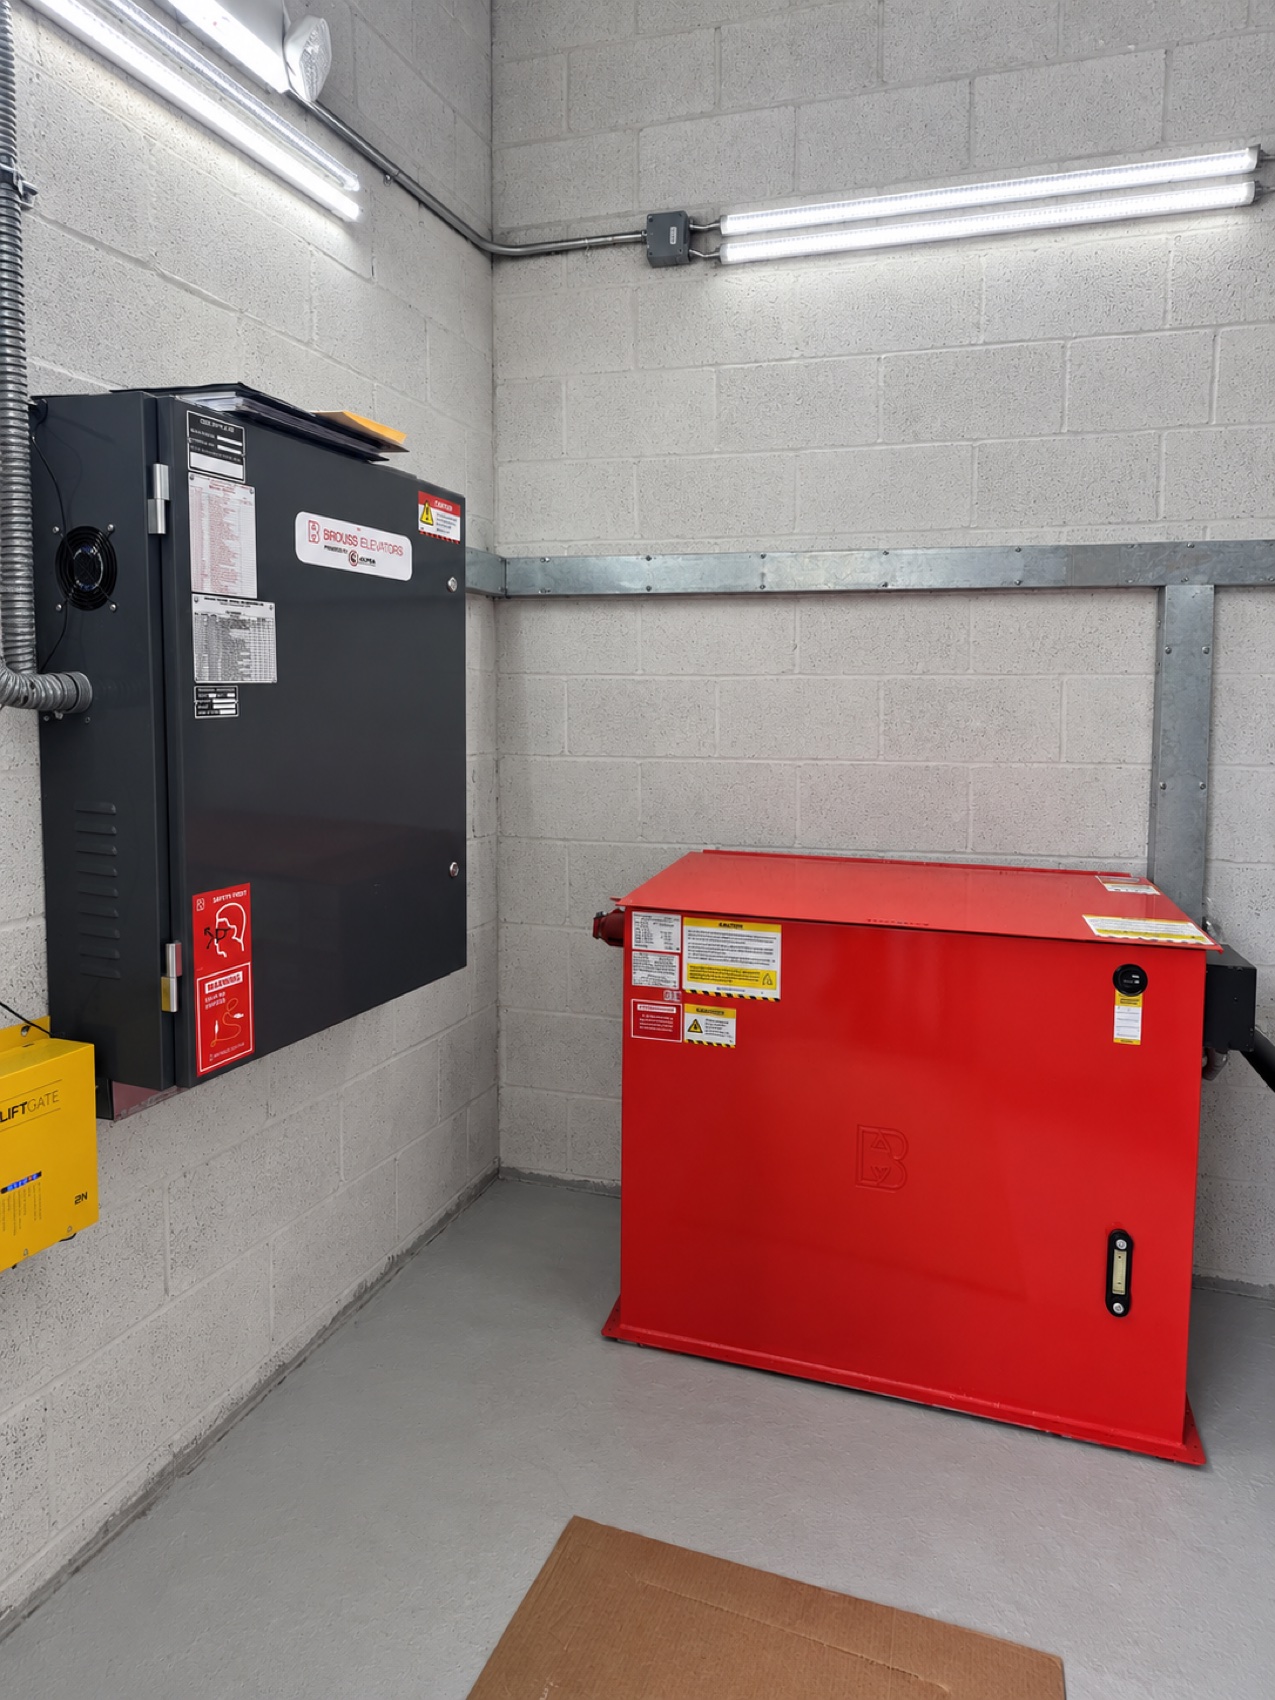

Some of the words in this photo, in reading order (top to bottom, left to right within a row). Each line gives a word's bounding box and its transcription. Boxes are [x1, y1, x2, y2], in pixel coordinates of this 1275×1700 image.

[323, 528, 358, 547] BROUSS
[360, 537, 404, 557] ELEVATORS
[74, 1191, 88, 1205] 2N
